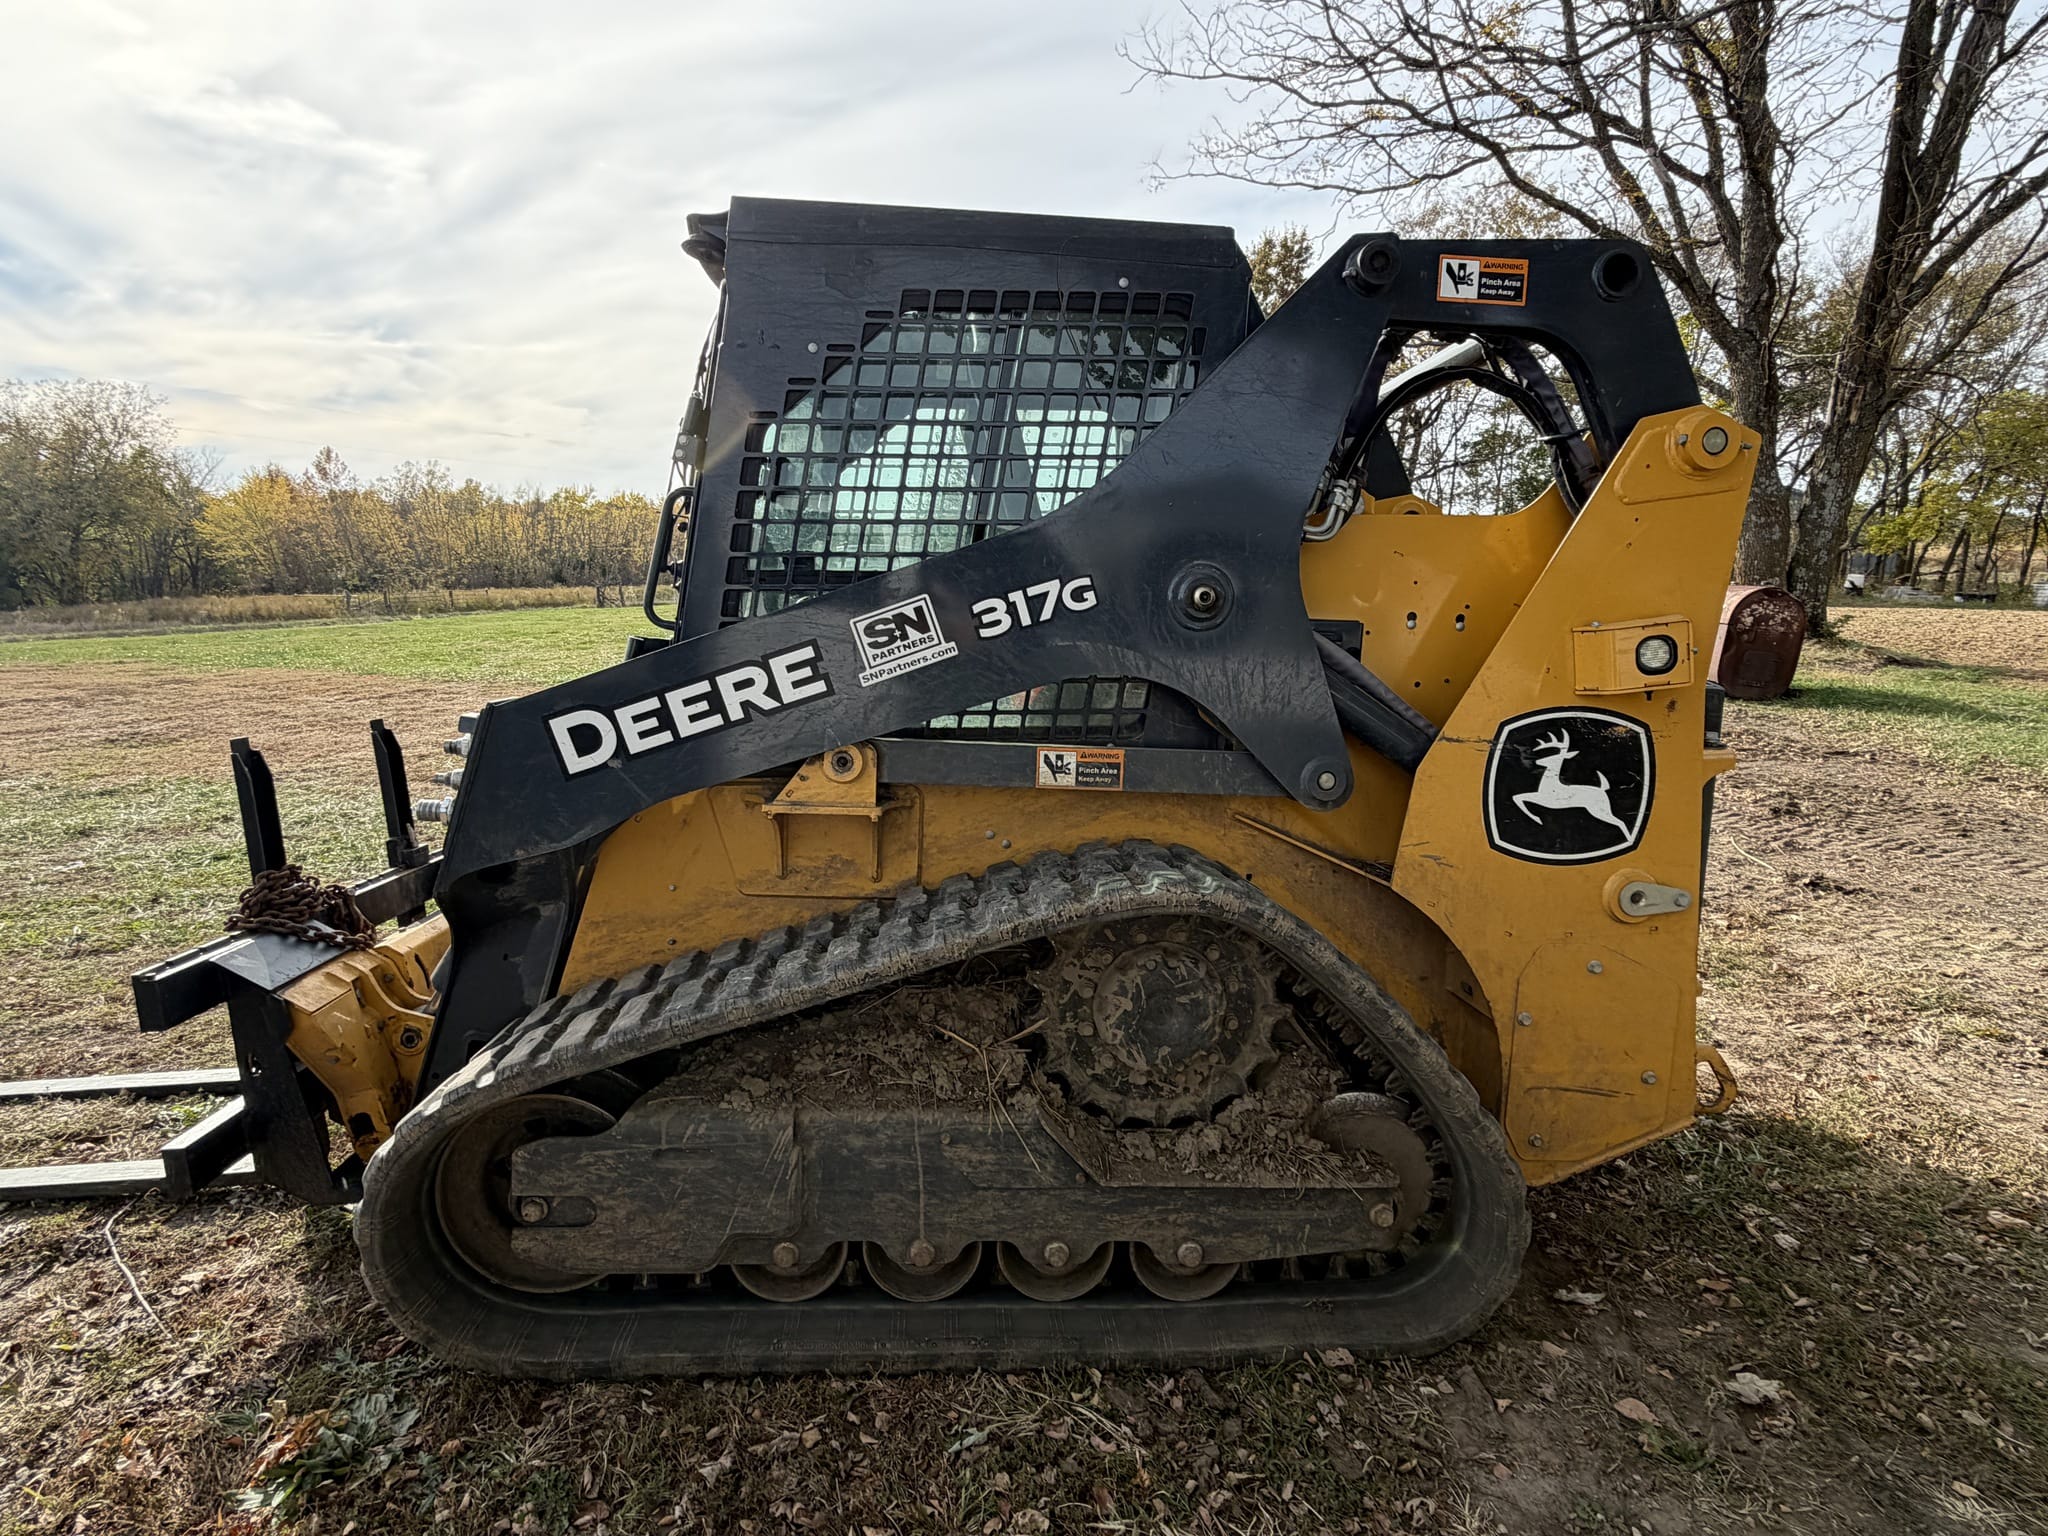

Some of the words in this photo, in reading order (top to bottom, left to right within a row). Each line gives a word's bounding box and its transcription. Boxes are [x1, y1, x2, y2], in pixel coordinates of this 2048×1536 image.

[1489, 261, 1524, 271] WARNING
[1481, 277, 1503, 286] Pinch
[1503, 278, 1521, 287] Area
[1480, 287, 1497, 296] Keep
[1497, 288, 1515, 297] Away
[972, 577, 1097, 638] 317G
[872, 634, 935, 662] PARTNERS
[862, 646, 956, 684] SNPartners.com
[549, 645, 828, 775] DEERE
[1087, 752, 1120, 760] WARNING
[1100, 767, 1118, 775] Area
[1094, 776, 1112, 784] Away
